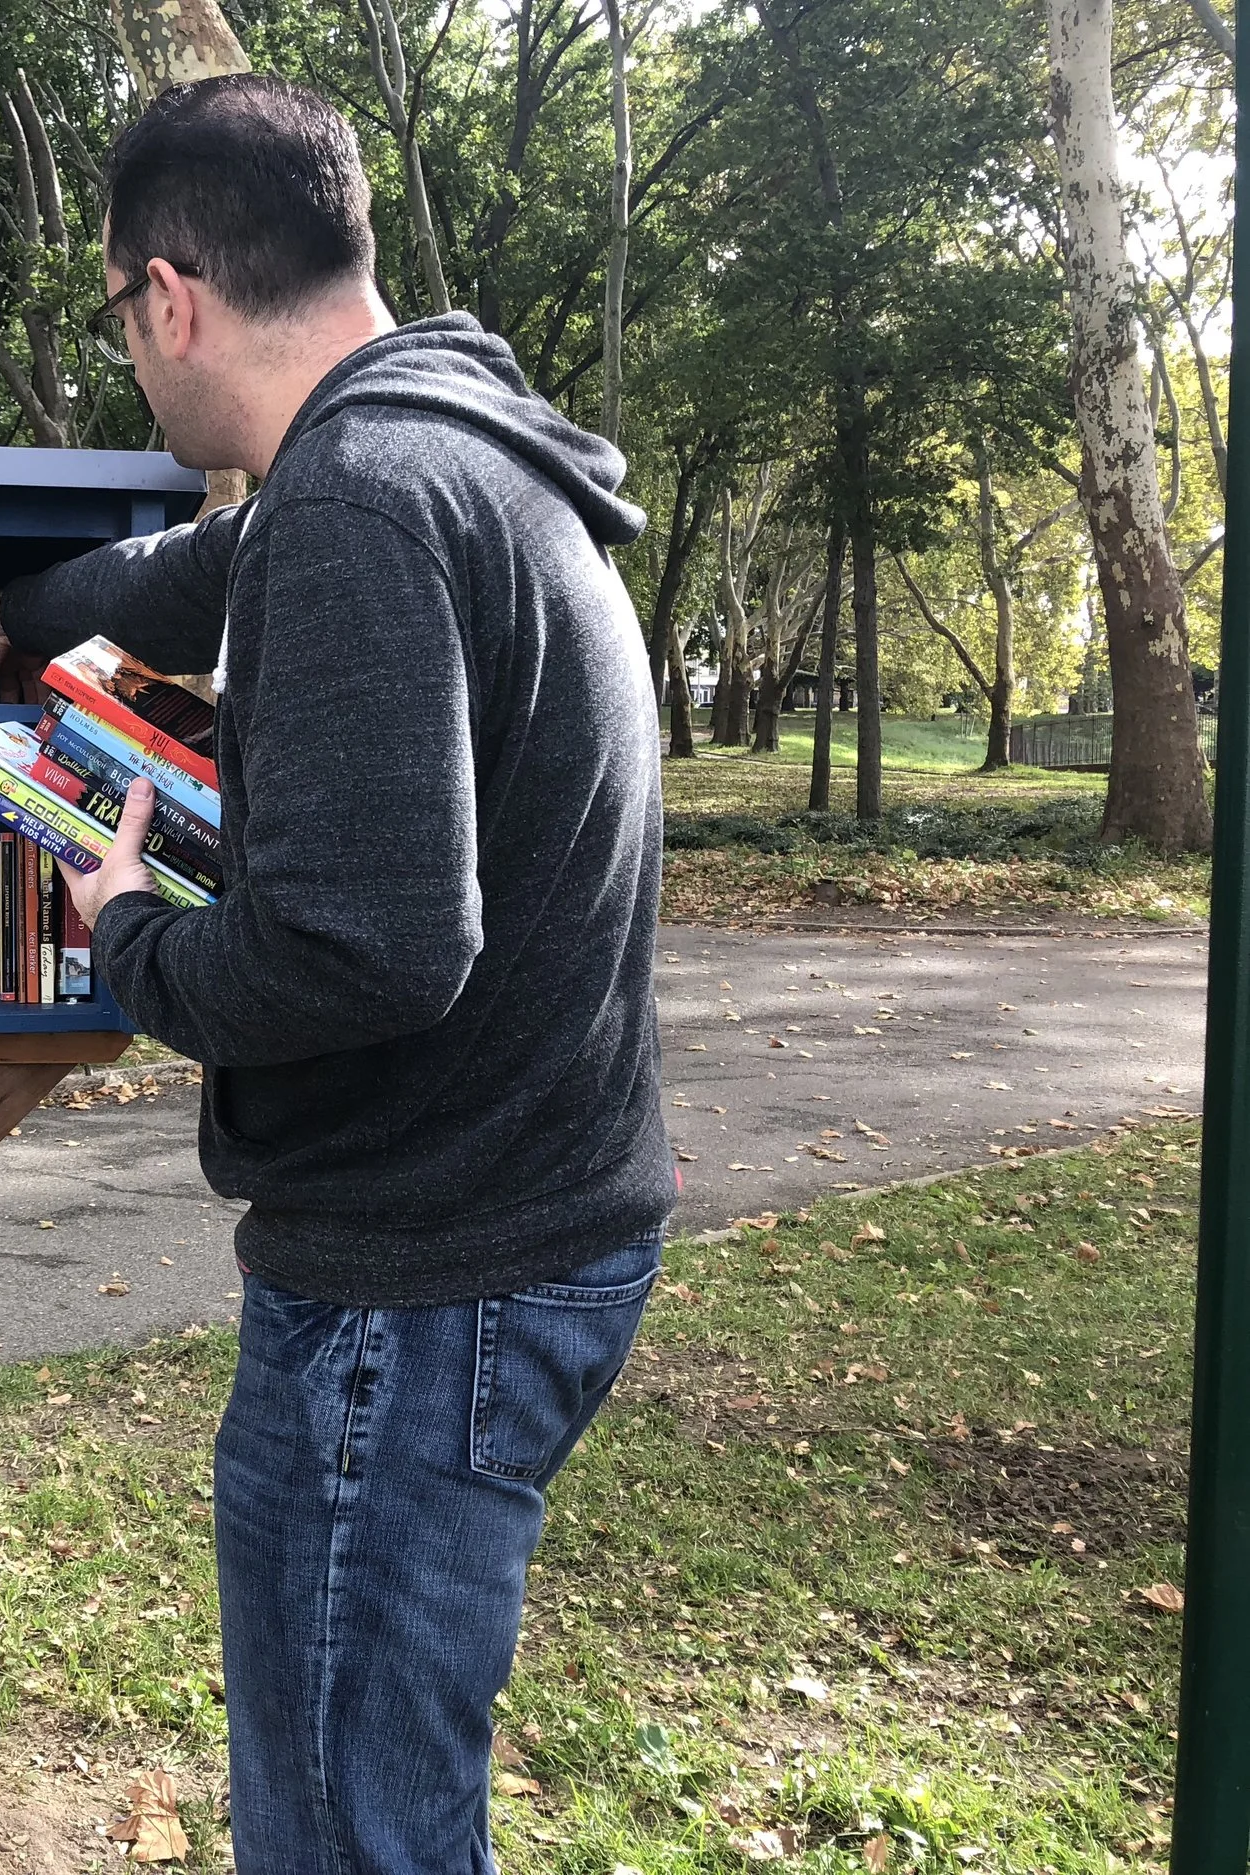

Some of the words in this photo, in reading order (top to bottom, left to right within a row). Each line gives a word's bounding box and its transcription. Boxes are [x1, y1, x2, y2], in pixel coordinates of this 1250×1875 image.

[68, 712, 100, 736] HOLMES
[55, 732, 70, 745] JOY
[41, 765, 72, 791] VIVAT
[125, 751, 142, 767] THE
[153, 770, 176, 791] HOUR
[18, 822, 40, 840] KIDS
[38, 835, 62, 854] WITH
[21, 814, 45, 833] HELP
[43, 828, 68, 847] YOUR
[184, 822, 221, 851] PAINT
[28, 854, 36, 889] Travelers
[193, 871, 217, 890] DOOM
[42, 901, 51, 931] Name
[28, 931, 36, 948] Keri
[42, 932, 51, 942] Is
[29, 948, 37, 974] Barker
[40, 945, 52, 978] Today
